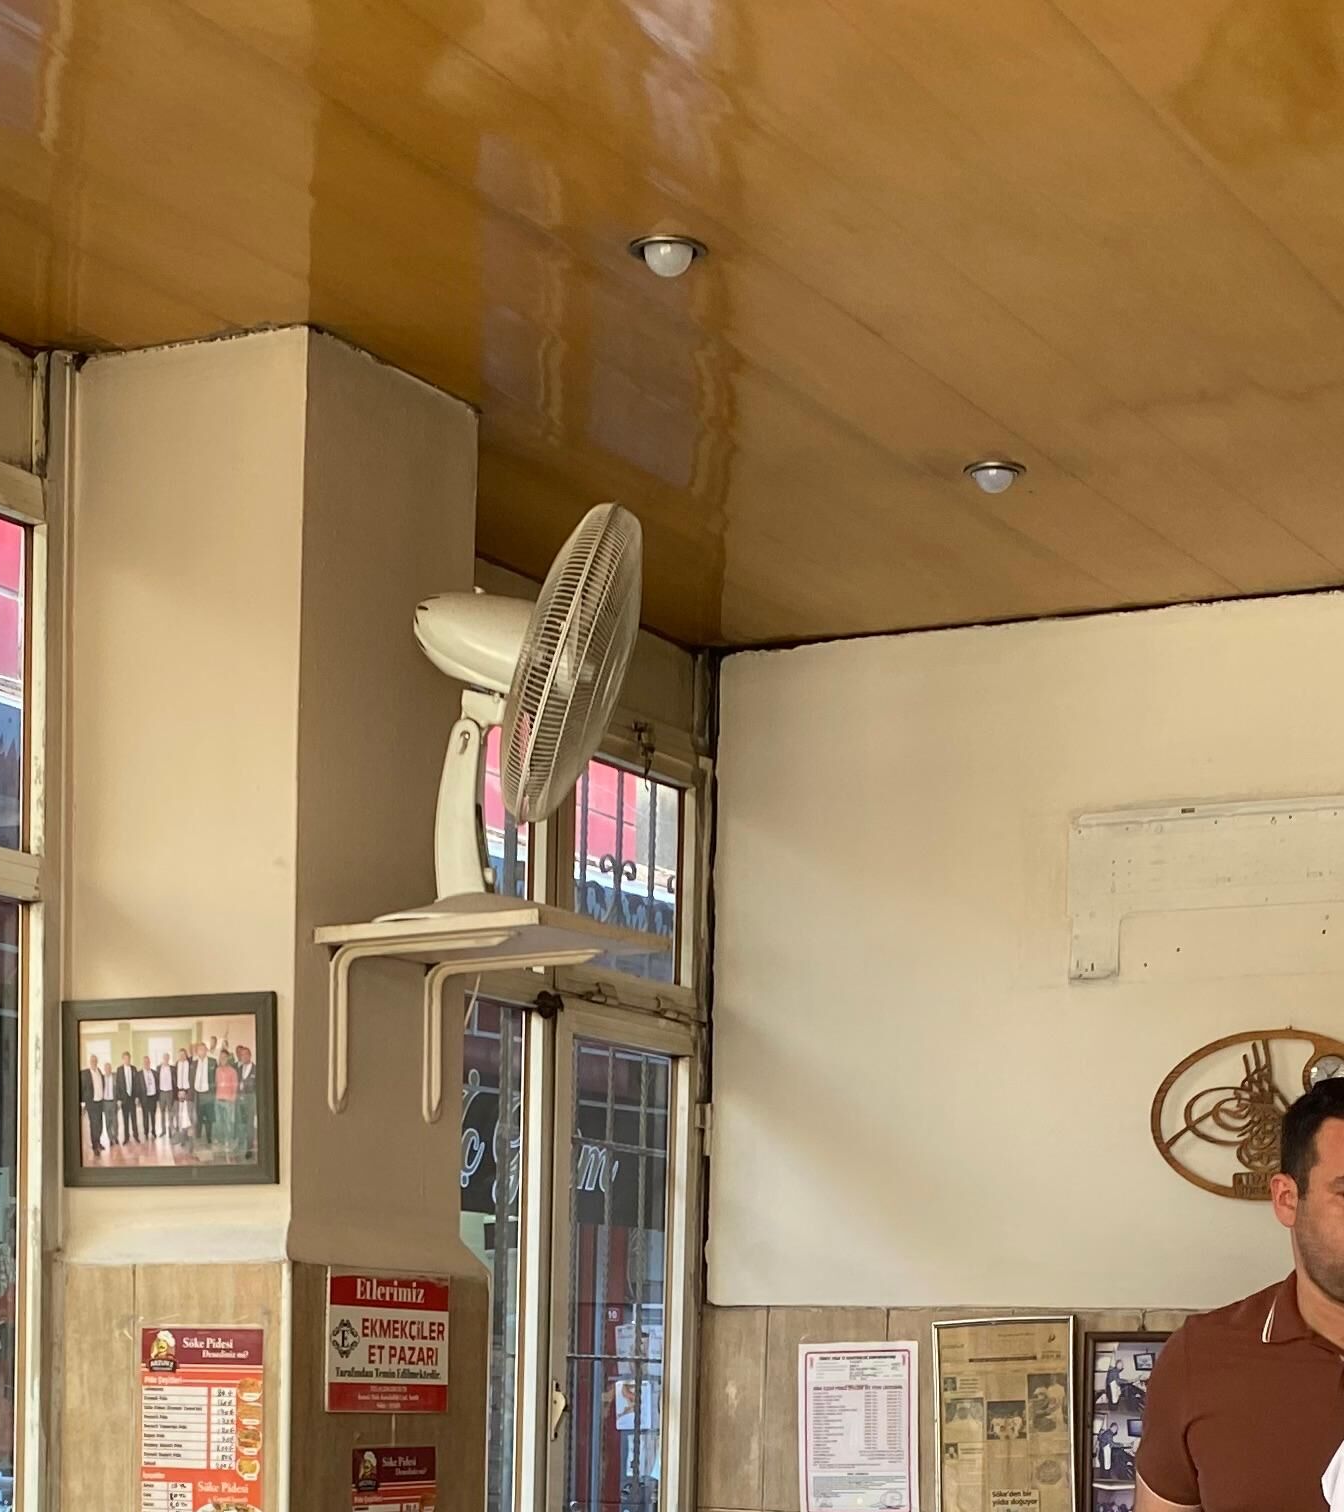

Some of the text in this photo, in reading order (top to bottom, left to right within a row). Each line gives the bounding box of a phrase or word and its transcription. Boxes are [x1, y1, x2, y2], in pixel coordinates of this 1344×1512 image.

[356, 1278, 425, 1304] Etlerimiz
[182, 1337, 233, 1349] Söke Pidesi
[368, 1345, 439, 1366] ET PAZARI
